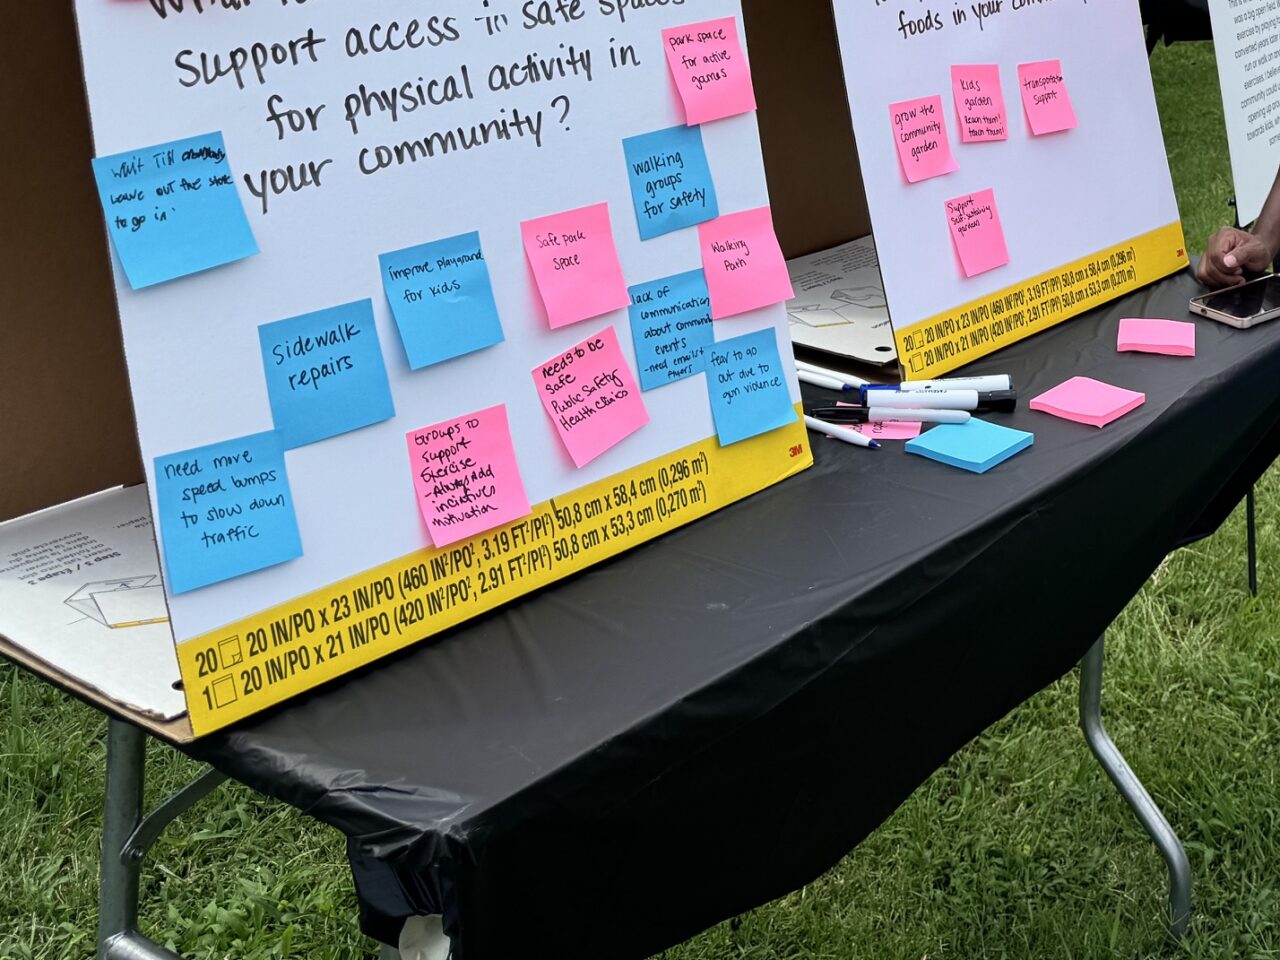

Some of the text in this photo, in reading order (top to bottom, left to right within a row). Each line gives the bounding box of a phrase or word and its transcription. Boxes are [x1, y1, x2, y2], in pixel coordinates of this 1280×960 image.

[897, 9, 944, 39] foods
[952, 1, 967, 26] in
[971, 0, 1003, 31] your
[345, 14, 460, 57] access
[668, 27, 727, 53] park space
[682, 48, 731, 69] for active
[266, 38, 641, 141] for physical activity in
[691, 67, 728, 90] games
[964, 95, 993, 111] garden
[894, 104, 935, 131] grow the
[900, 120, 942, 143] community
[632, 151, 684, 177] walking
[911, 140, 938, 162] garden
[244, 155, 334, 215] your
[645, 172, 683, 198] groups
[643, 188, 707, 220] for safety
[131, 214, 146, 232] go
[388, 249, 484, 281] improve playground
[403, 279, 461, 304] for kids
[632, 285, 671, 305] lack of
[644, 322, 672, 339] about
[903, 314, 971, 353] 20 20 IN/PO 23
[588, 337, 605, 353] be
[654, 337, 688, 356] events
[710, 346, 758, 367] fear to go
[288, 355, 354, 391] repairs
[717, 363, 771, 384] out due to
[722, 377, 782, 405] gun violence
[560, 405, 597, 433] Health
[788, 443, 803, 459] 3M
[164, 450, 253, 480] need more
[181, 469, 277, 504] speed bumps
[180, 493, 285, 528] to slow down
[201, 524, 260, 548] traffic
[94, 551, 122, 563] Step
[195, 480, 658, 678] 20 20 IN/PO 23 IN/PO (460 50,8 58,4 cm
[240, 645, 311, 696] 20 IN/PO
